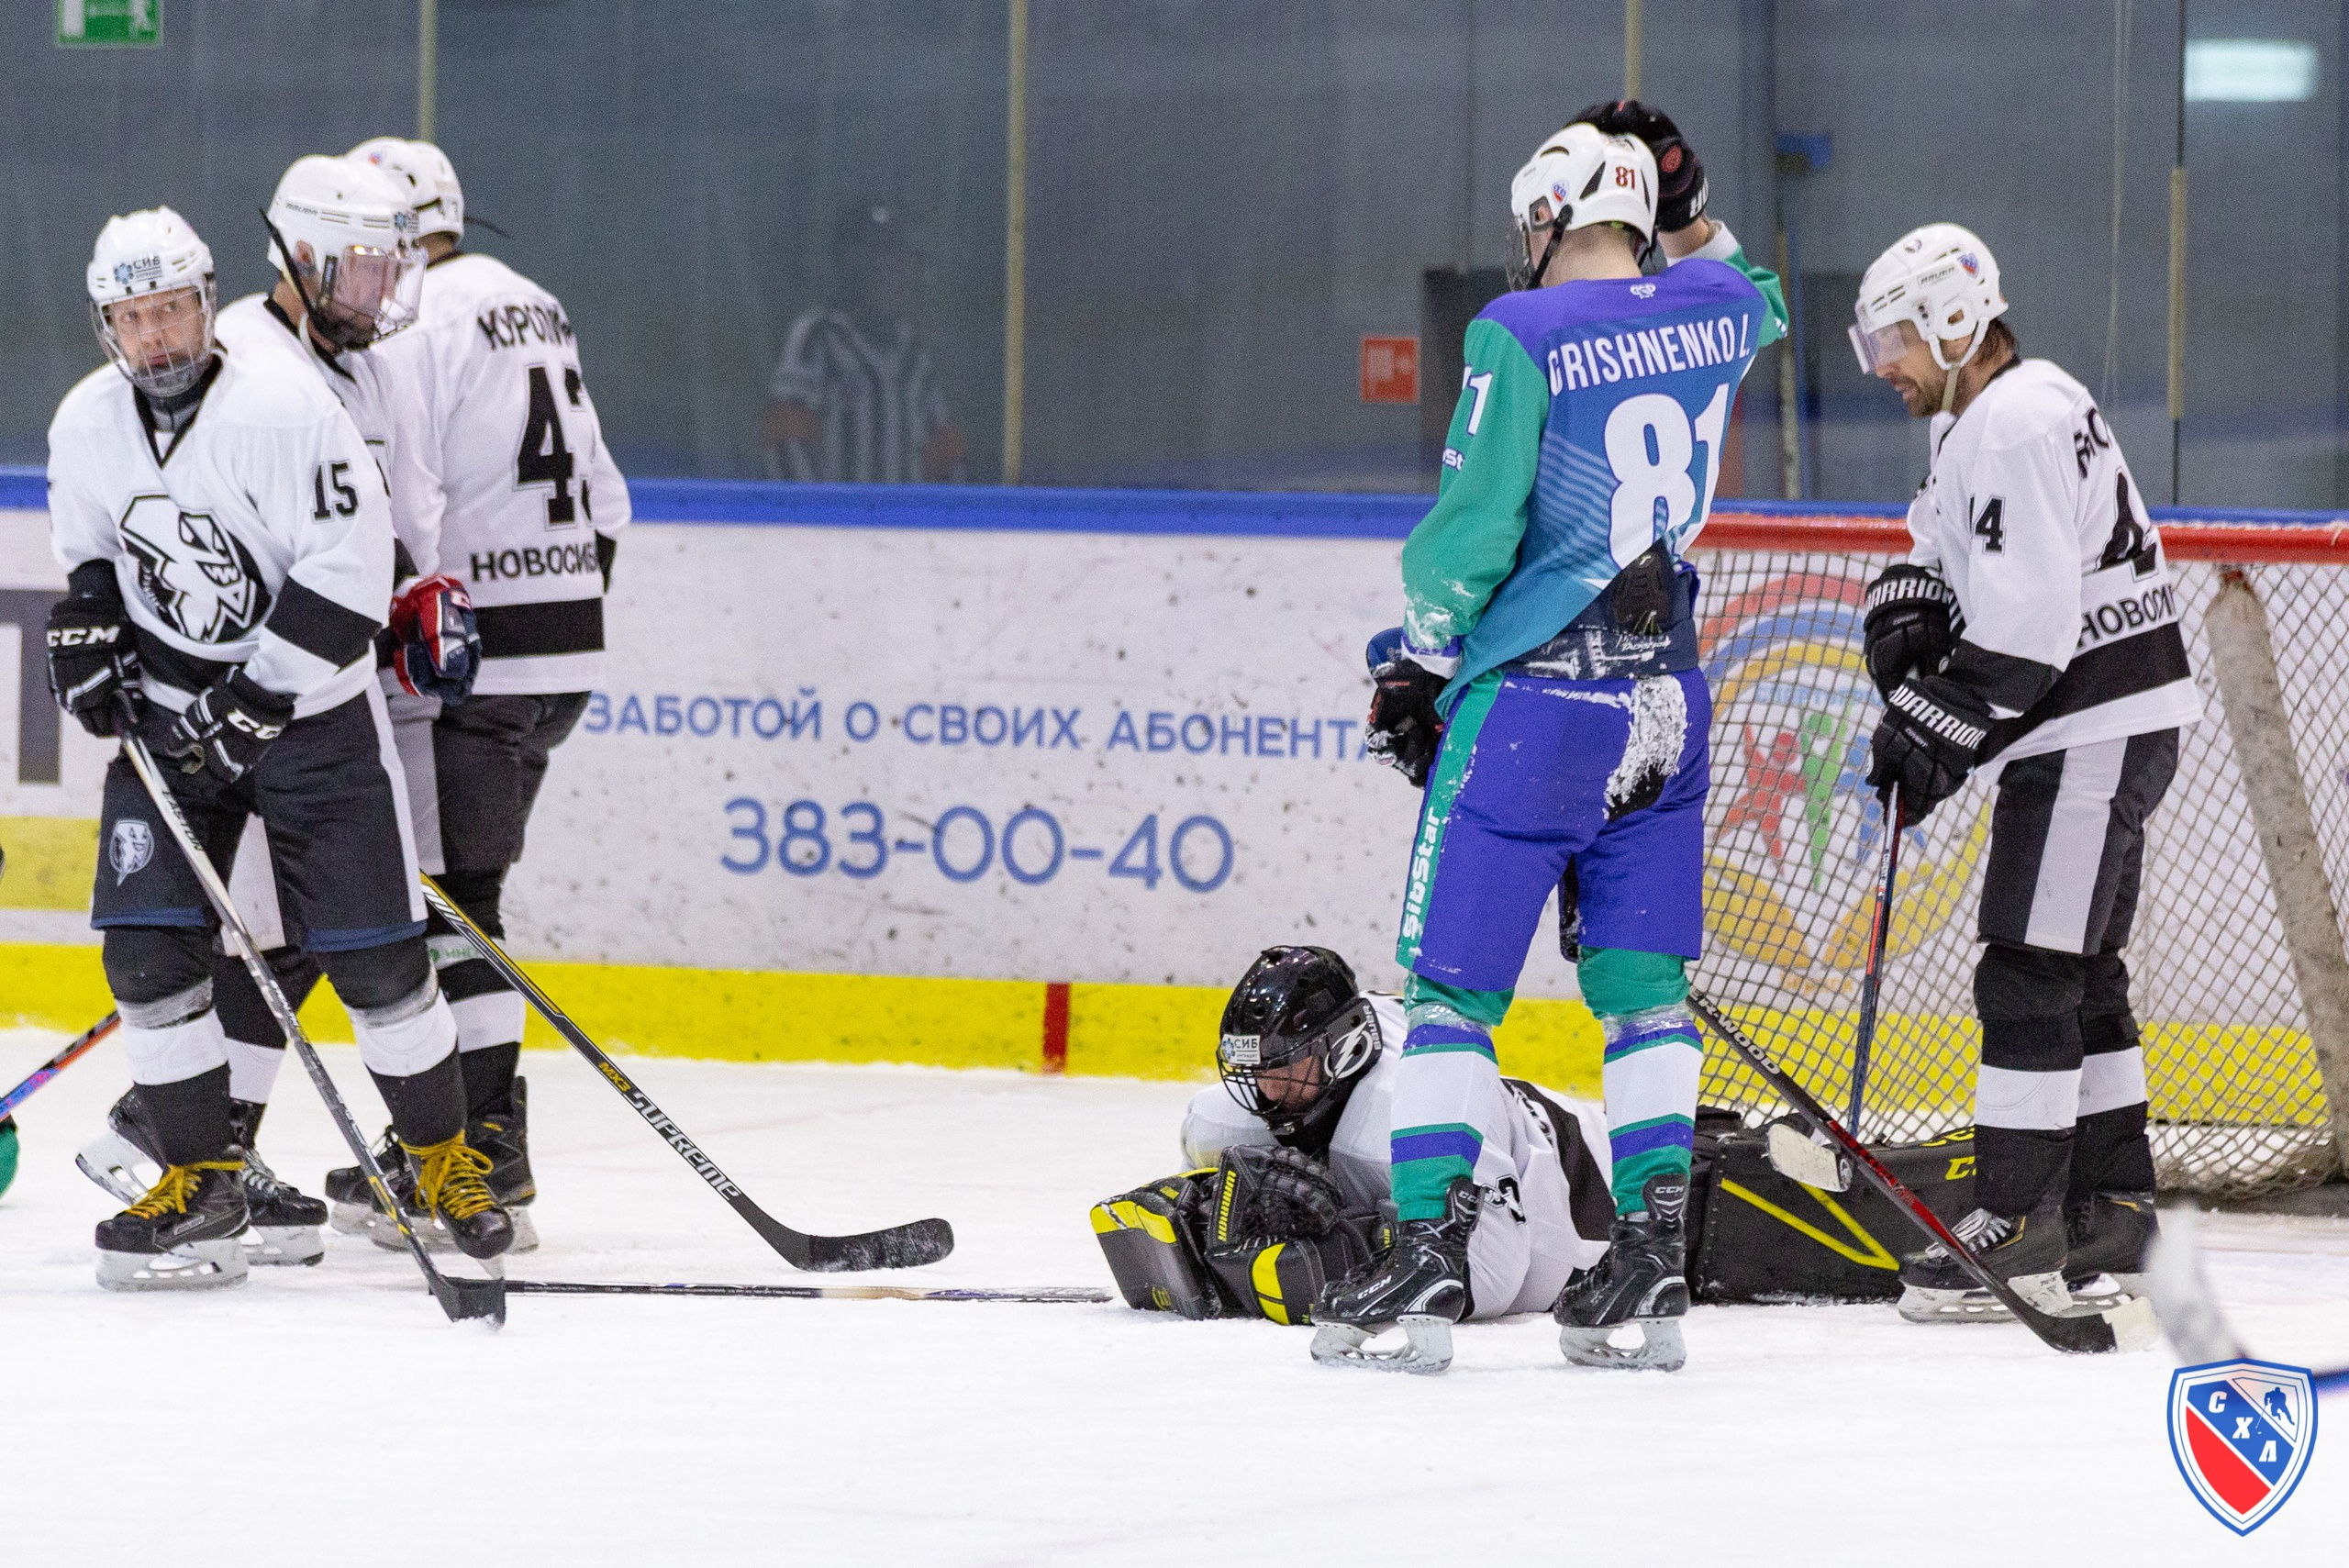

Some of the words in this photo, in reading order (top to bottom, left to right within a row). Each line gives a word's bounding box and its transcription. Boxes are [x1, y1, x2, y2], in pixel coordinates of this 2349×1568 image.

[1614, 166, 1636, 190] 81
[1548, 316, 1736, 396] GRISHNENKO
[313, 460, 360, 521] 15
[1604, 382, 1730, 571] 81
[584, 687, 822, 740] ЗАБОТОЙ
[845, 702, 880, 742] О
[903, 703, 1083, 751] СВОИХ
[1889, 684, 1987, 751] WARRIOR
[719, 796, 1235, 895] 383-00-40
[1234, 1038, 1258, 1049] СИБ
[1363, 1005, 1382, 1051] BAUER
[598, 1062, 631, 1093] MX3
[633, 1087, 741, 1198] SUPREME
[1218, 1170, 1237, 1242] WARRIOR
[1654, 1185, 1685, 1195] CCM
[1357, 1274, 1392, 1300] CCM
